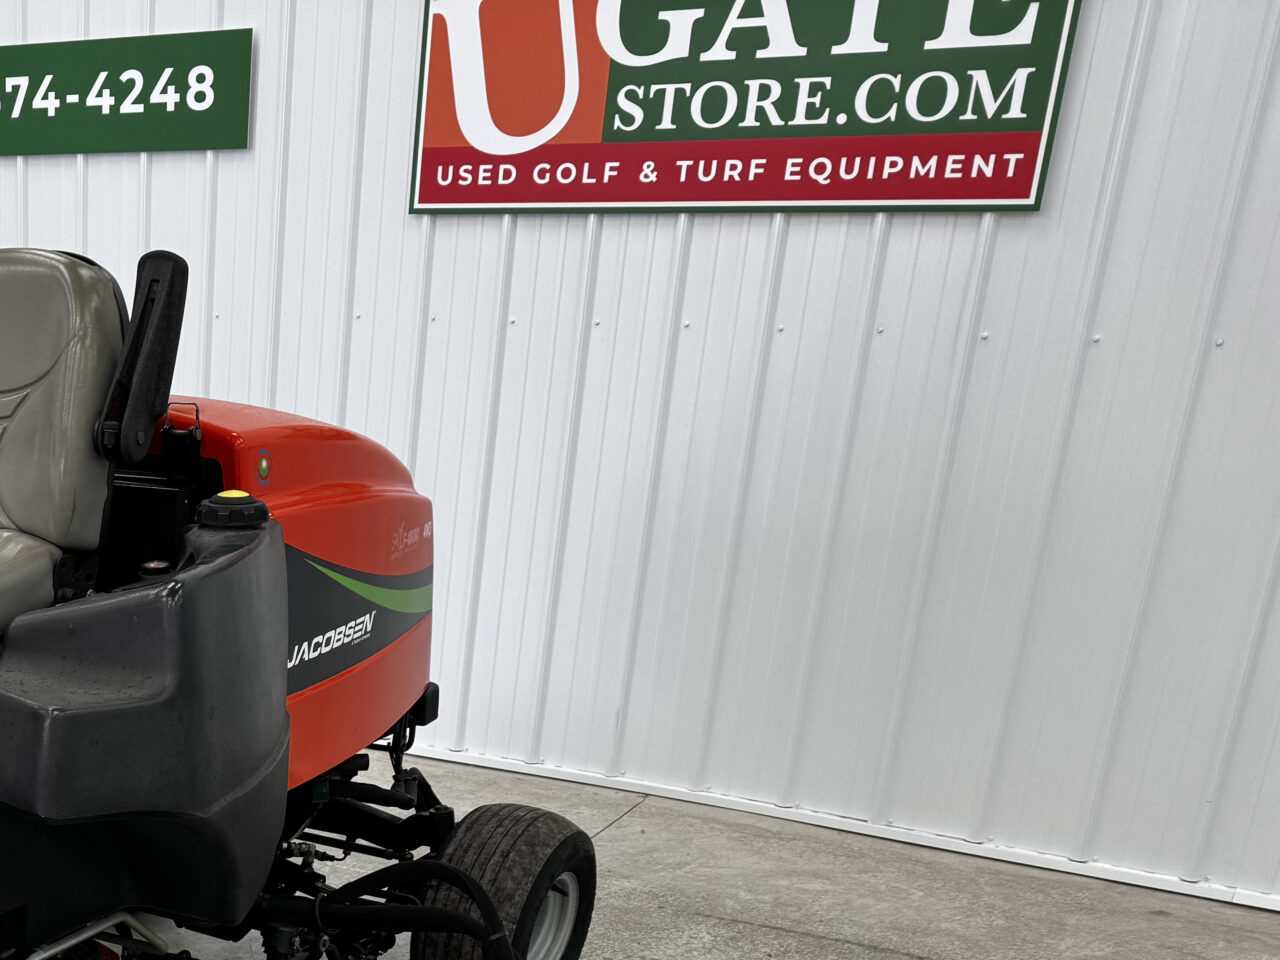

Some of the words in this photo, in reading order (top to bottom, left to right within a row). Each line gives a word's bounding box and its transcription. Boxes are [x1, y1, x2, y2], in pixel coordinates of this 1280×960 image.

[613, 67, 1036, 132] STORE.COM
[436, 163, 518, 187] USED
[532, 160, 620, 185] GOLF
[638, 161, 658, 184] &
[675, 158, 767, 183] TURF
[783, 153, 1025, 185] EQUIPMENT
[287, 609, 377, 669] JACOBSEN
